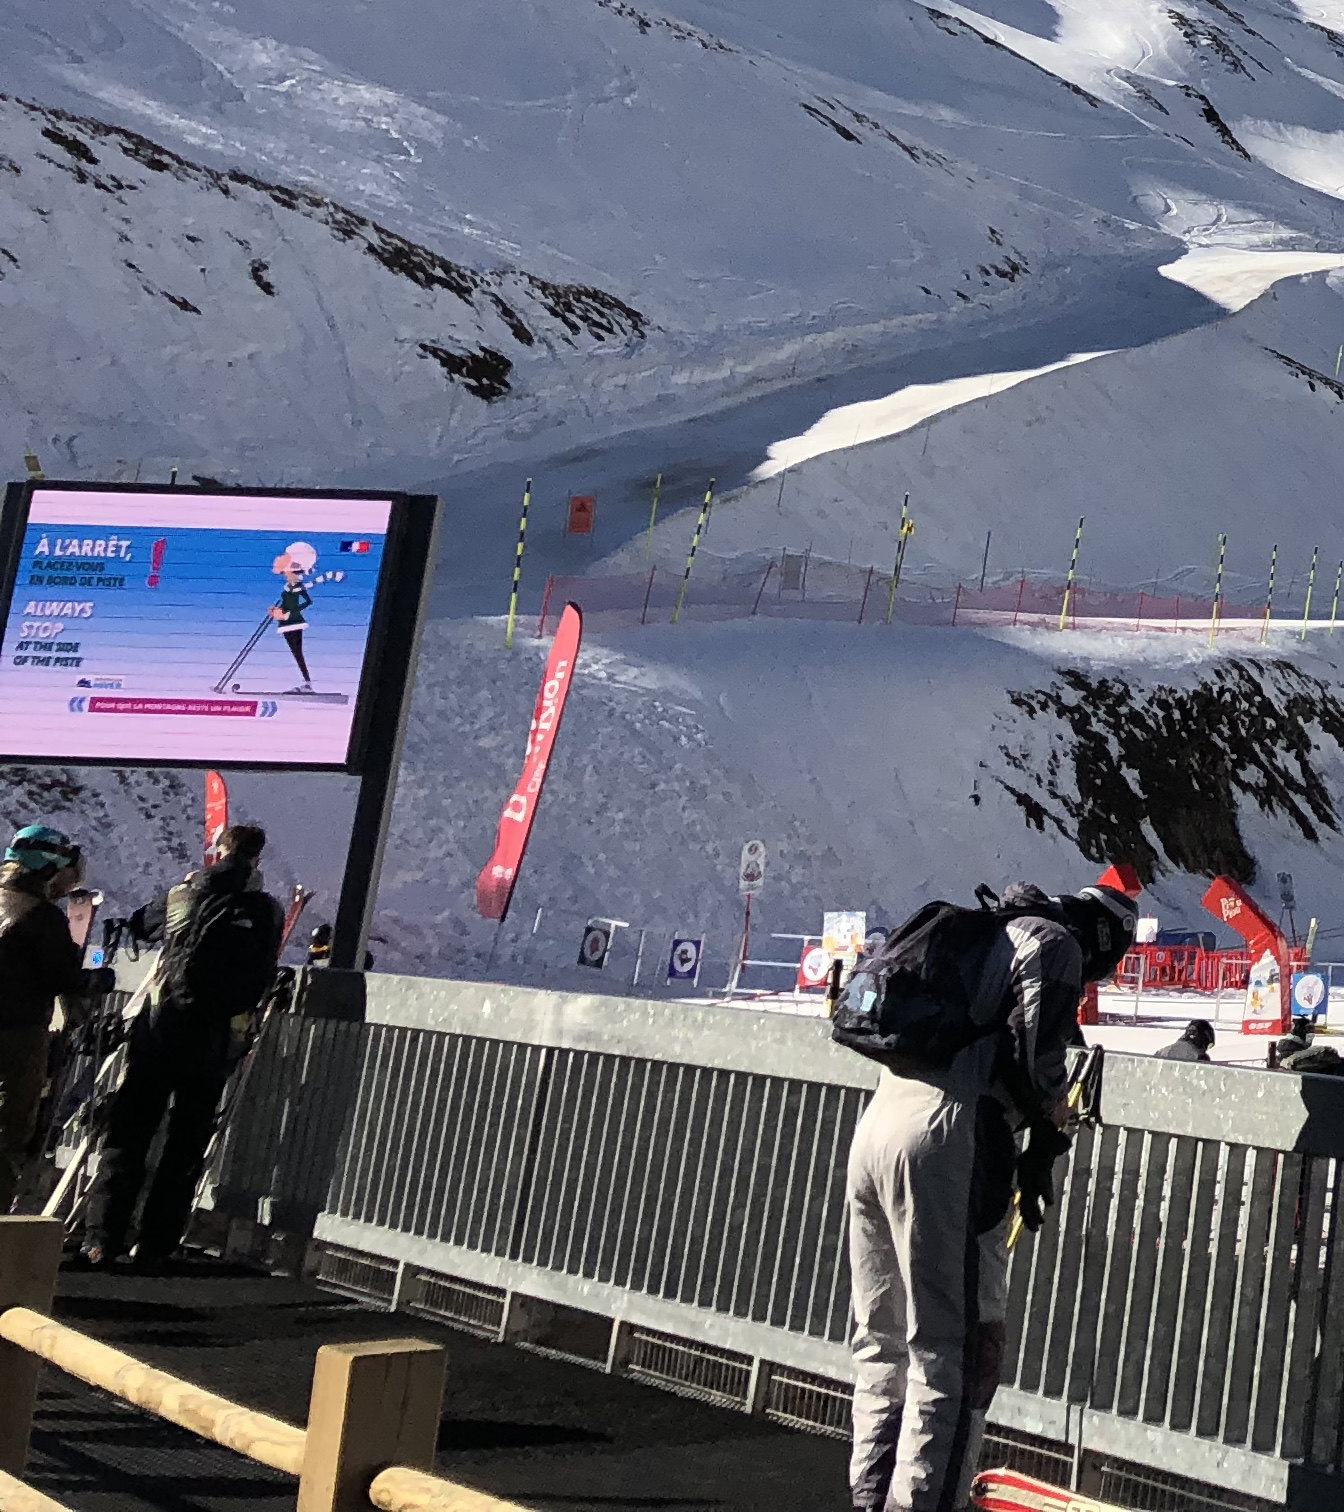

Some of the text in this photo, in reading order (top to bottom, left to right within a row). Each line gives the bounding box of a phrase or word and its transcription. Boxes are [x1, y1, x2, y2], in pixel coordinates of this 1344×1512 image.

[96, 577, 126, 587] PISTE
[23, 600, 95, 618] ALWAYS
[20, 621, 64, 639] STOP
[15, 640, 80, 653] AT THE SIDE
[13, 655, 83, 668] OF THE PISTE
